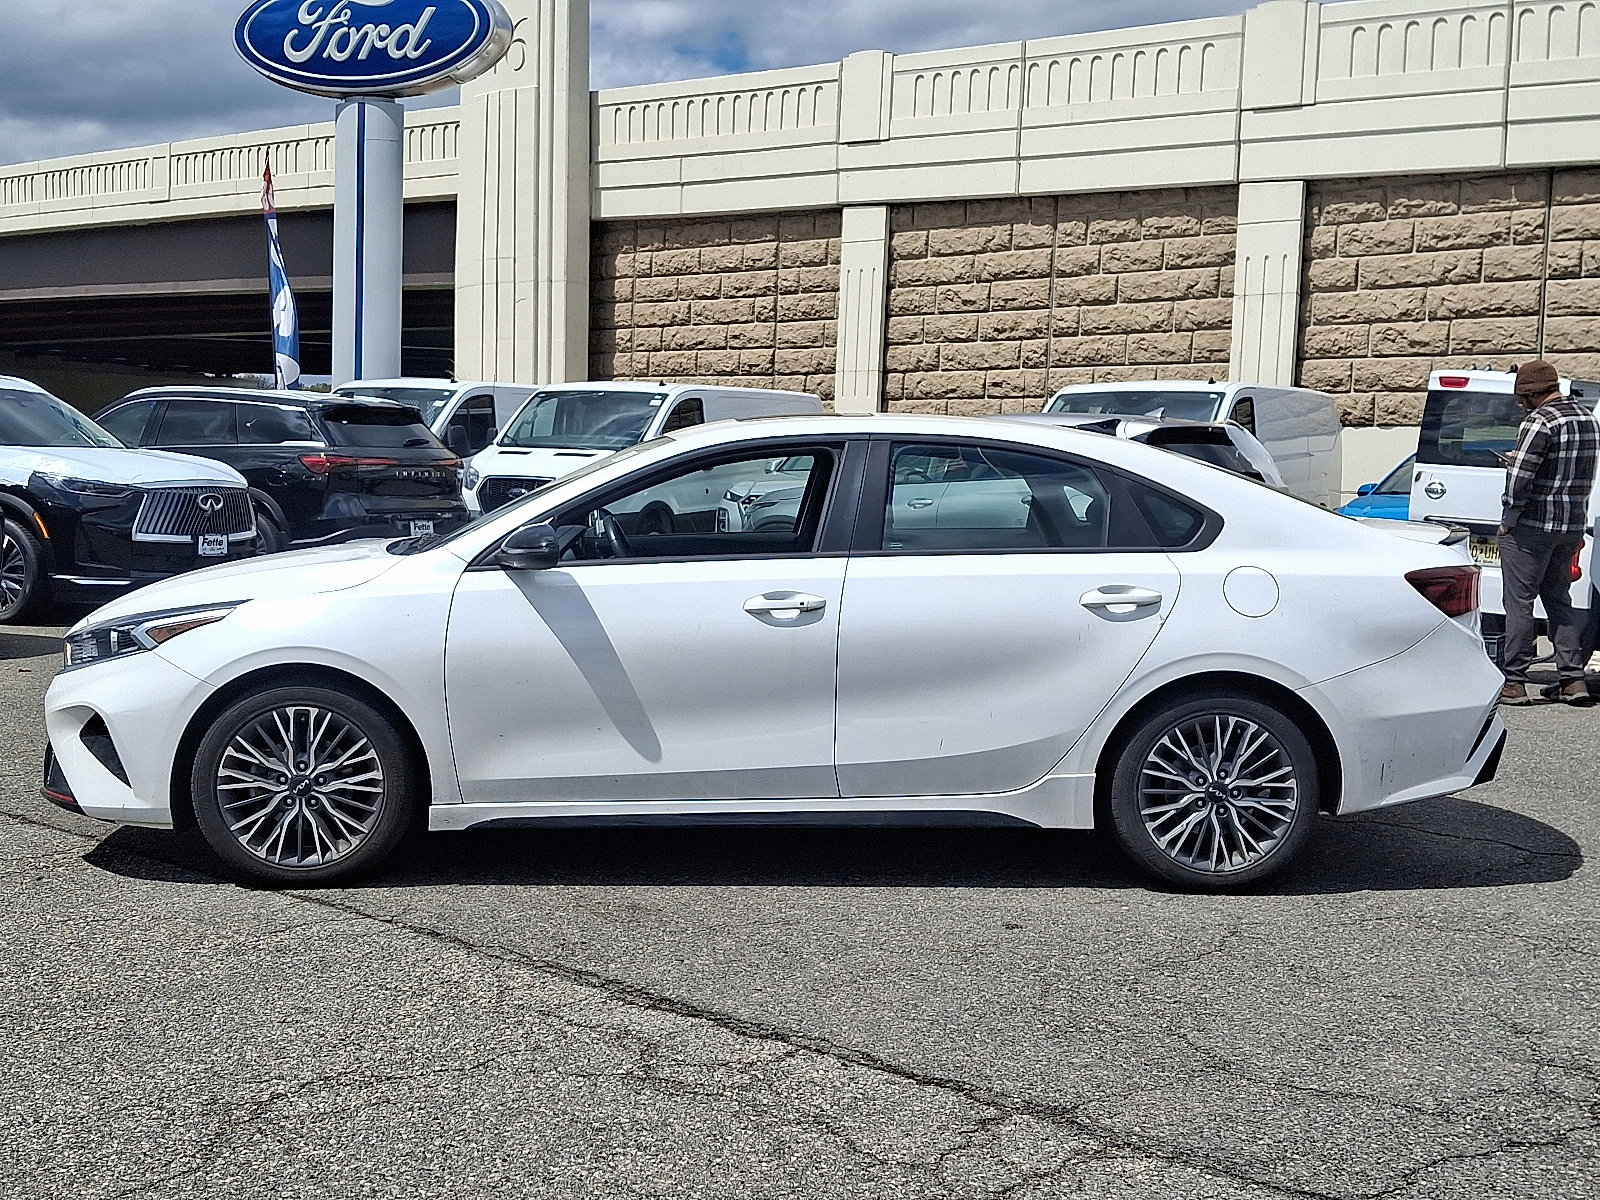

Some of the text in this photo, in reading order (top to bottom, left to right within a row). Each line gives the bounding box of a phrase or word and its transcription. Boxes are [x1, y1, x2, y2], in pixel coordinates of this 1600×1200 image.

[283, 0, 437, 62] Ford
[396, 470, 446, 478] INFINITI
[201, 537, 224, 547] Fette
